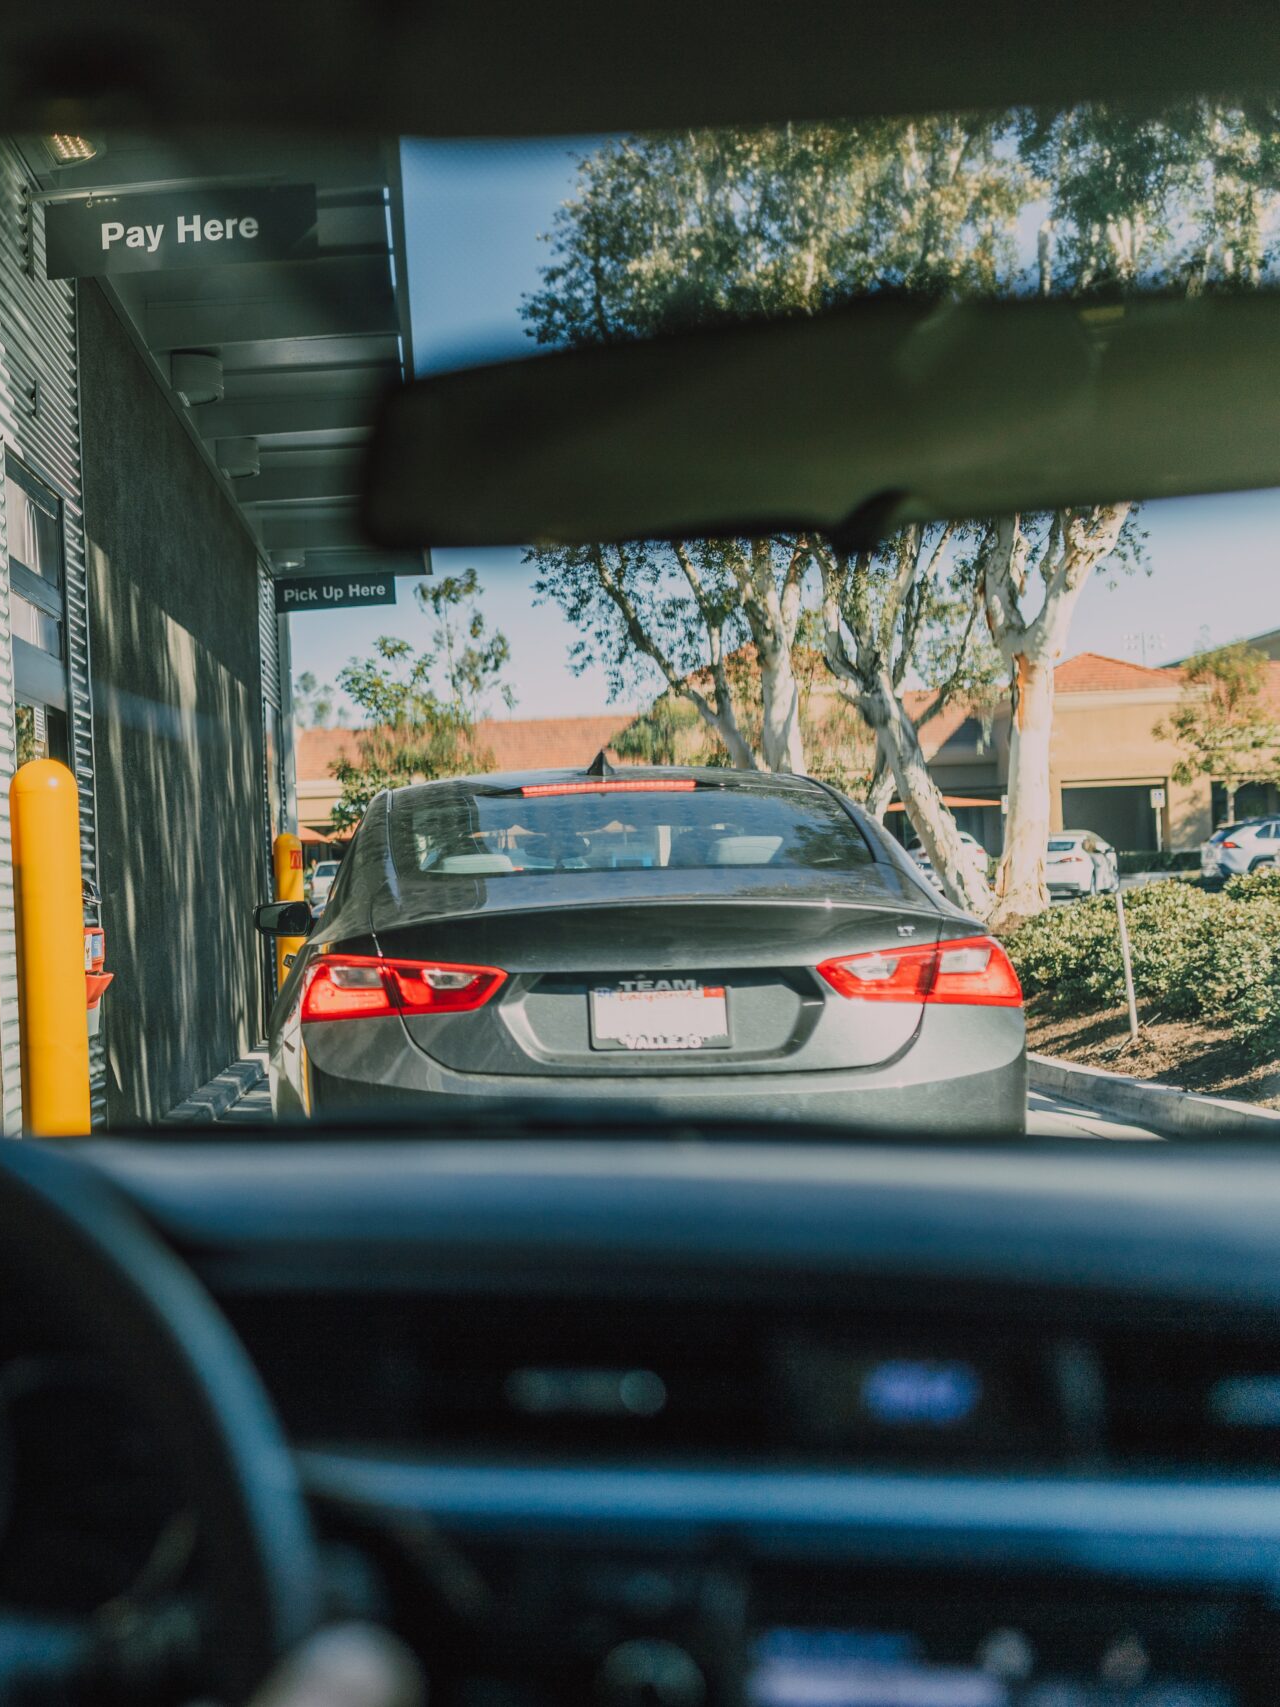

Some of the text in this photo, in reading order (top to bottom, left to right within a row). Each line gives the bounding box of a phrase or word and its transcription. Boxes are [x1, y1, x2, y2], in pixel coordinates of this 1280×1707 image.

[101, 214, 259, 253] Pay Here
[283, 583, 386, 603] Pick Up Here
[897, 925, 915, 936] LT
[618, 979, 697, 992] TEAM
